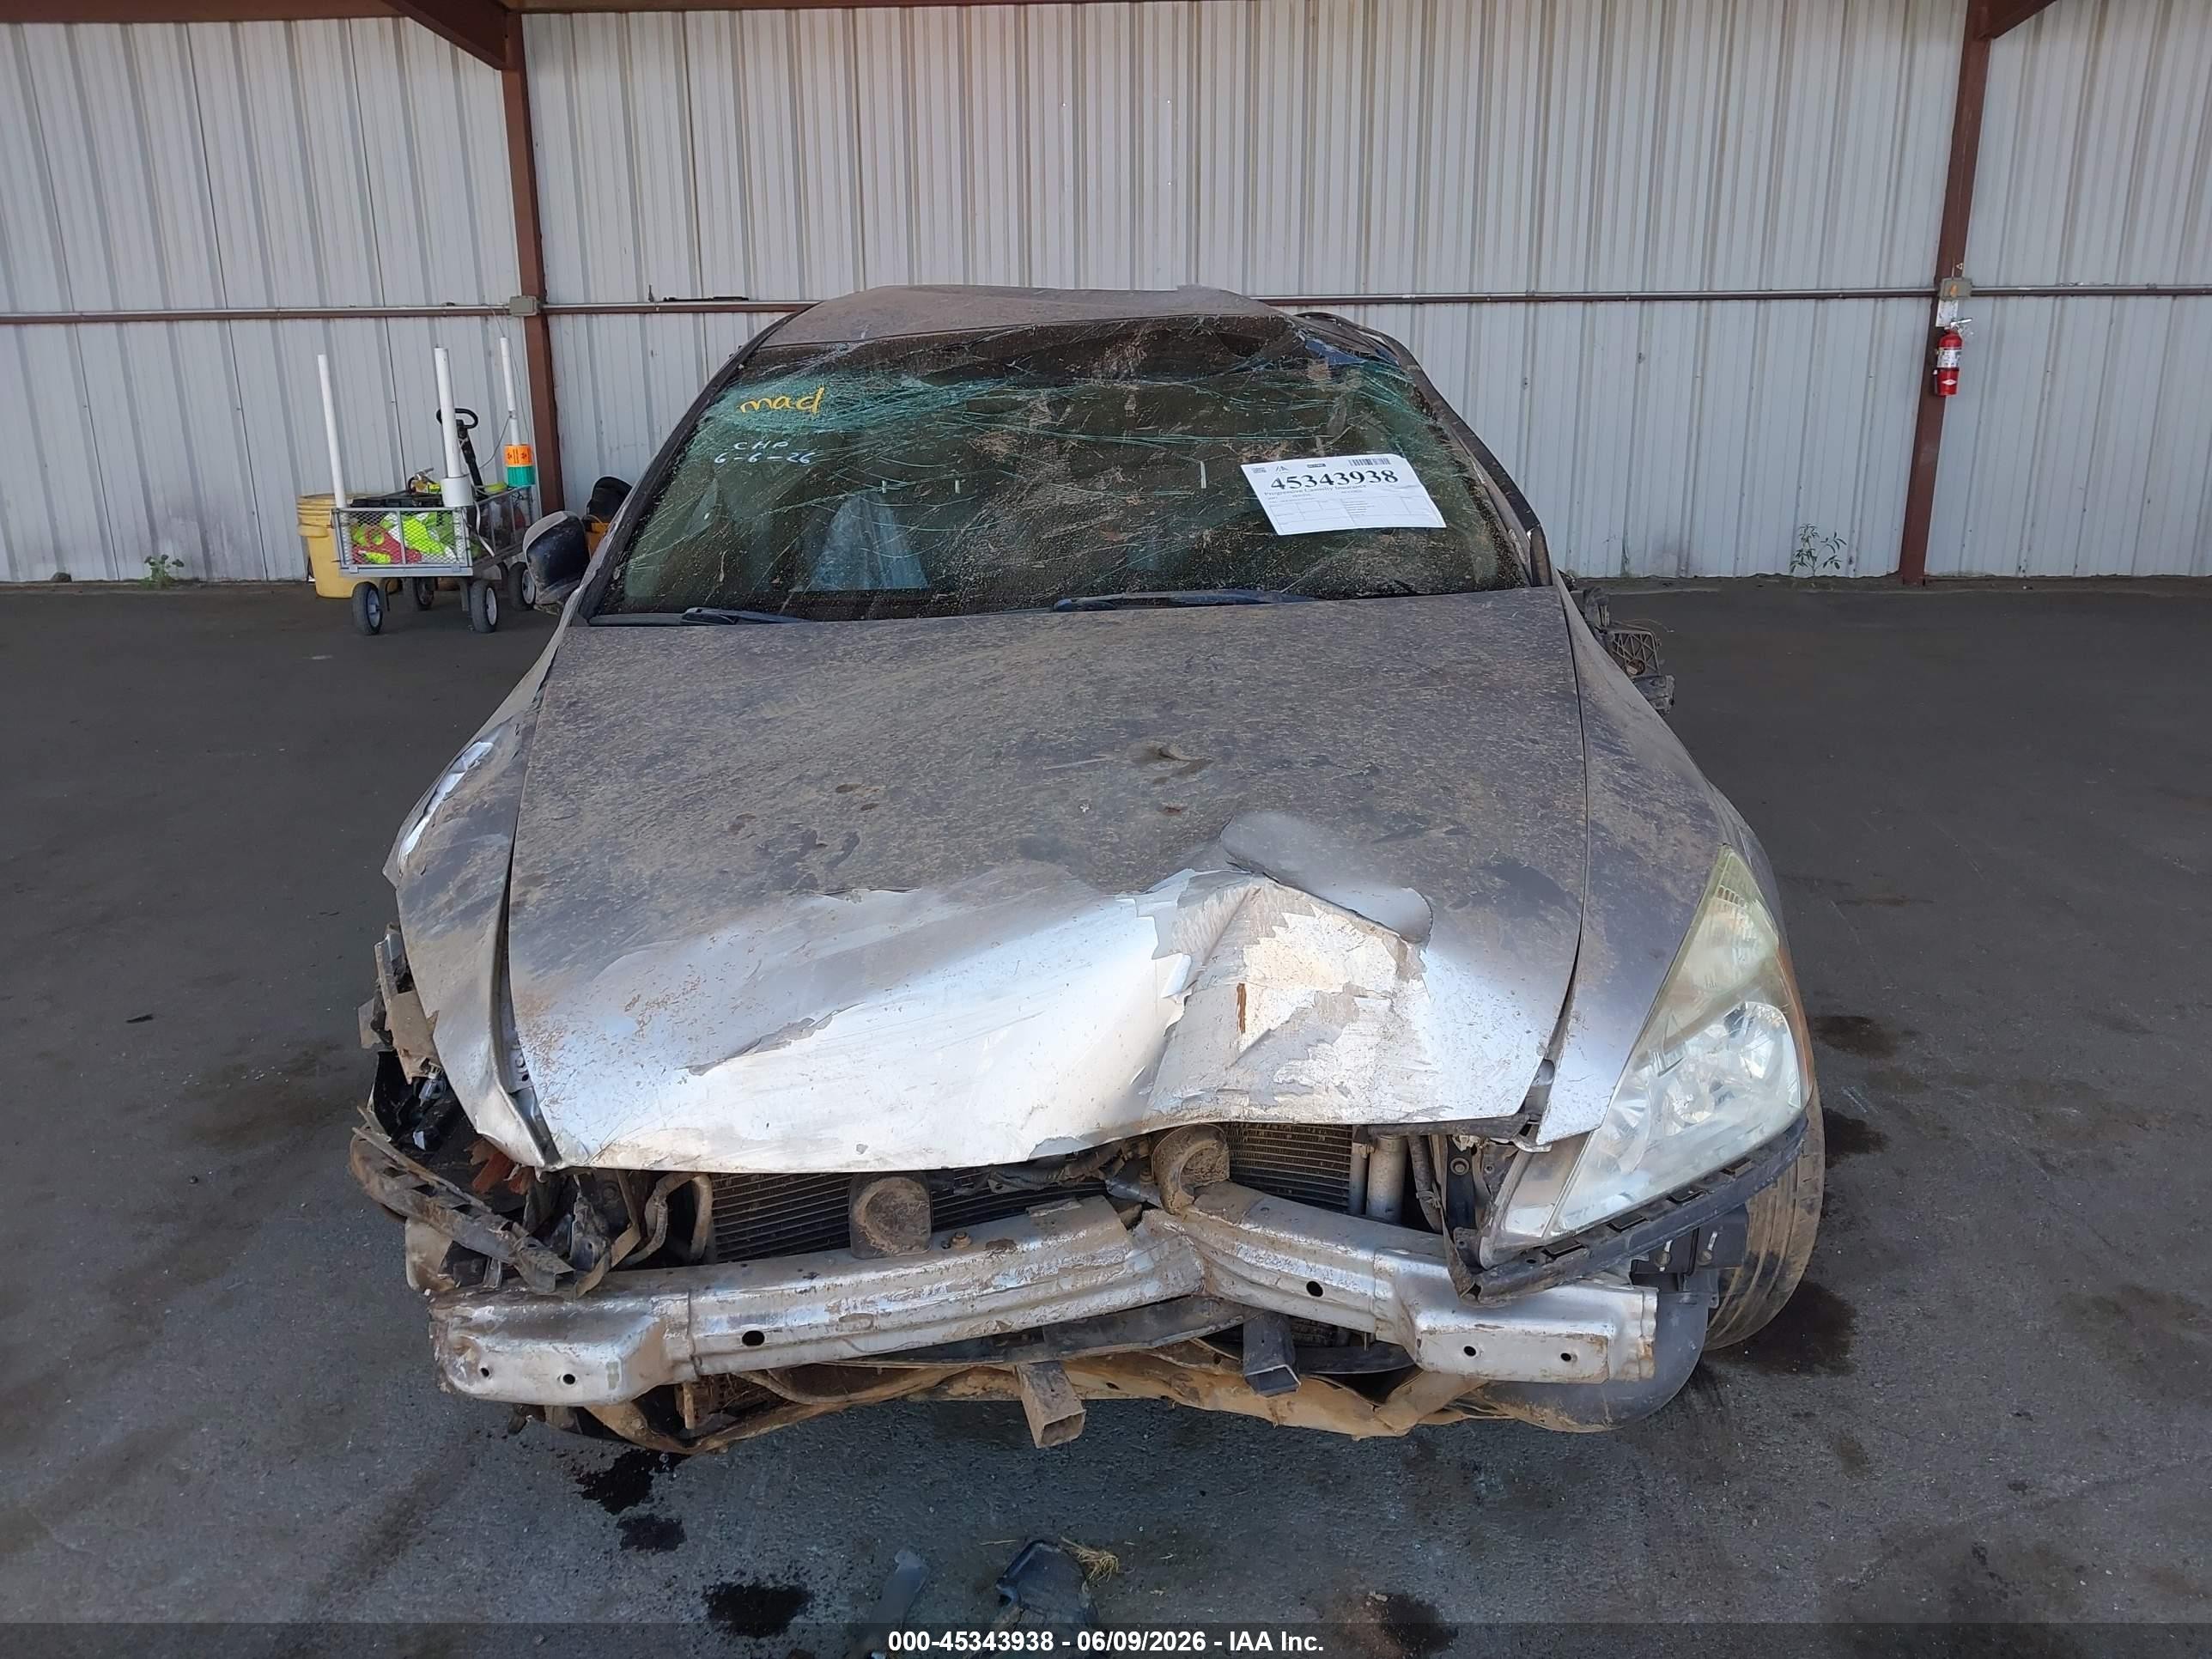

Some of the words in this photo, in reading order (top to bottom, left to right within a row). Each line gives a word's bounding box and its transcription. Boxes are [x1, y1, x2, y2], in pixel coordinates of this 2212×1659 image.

[737, 386, 825, 414] mad
[733, 440, 790, 451] CHP
[1270, 469, 1399, 490] 45343938
